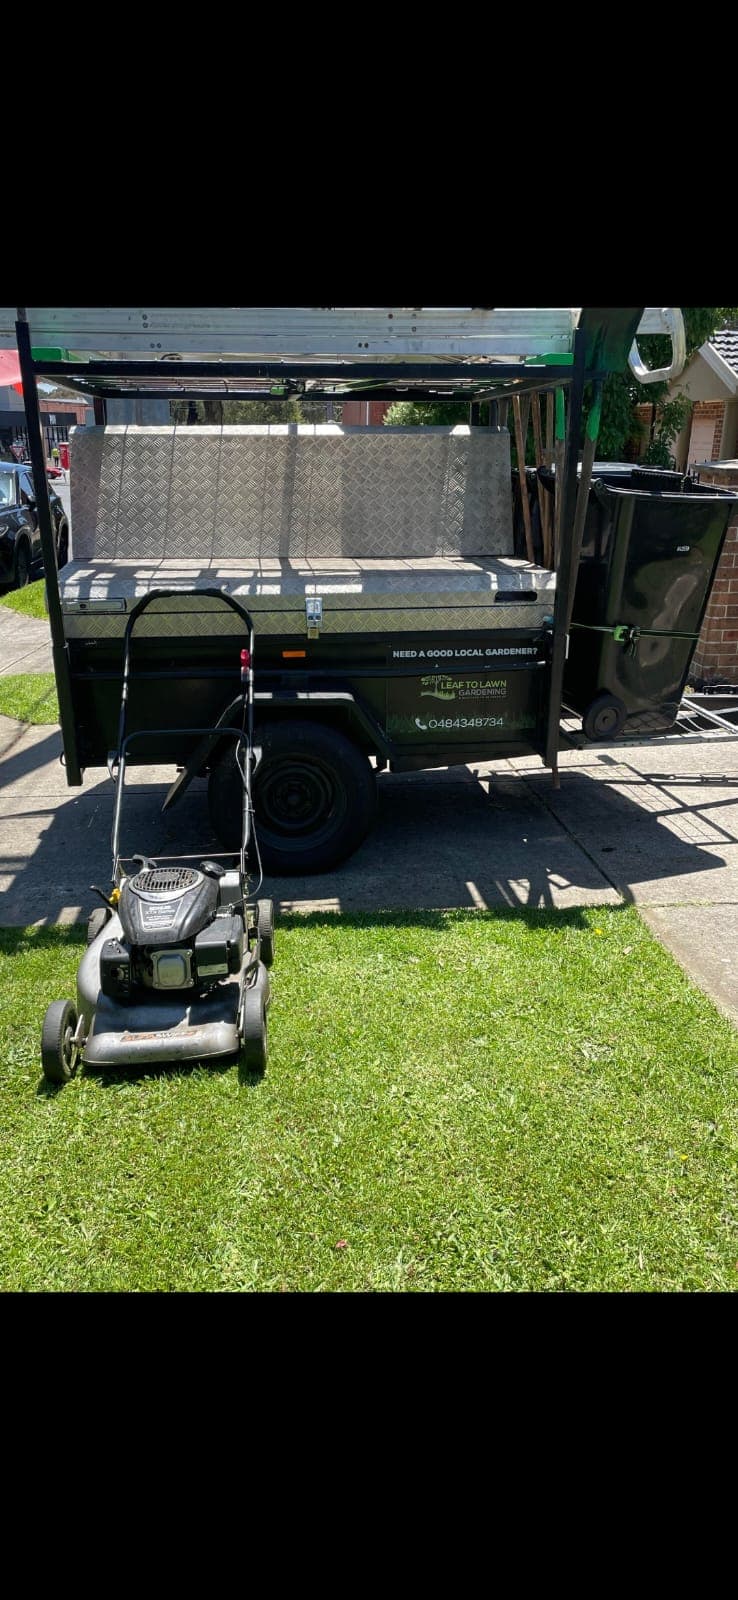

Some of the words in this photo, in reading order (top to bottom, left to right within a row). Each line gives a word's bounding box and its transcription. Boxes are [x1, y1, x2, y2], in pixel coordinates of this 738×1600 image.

[393, 650, 417, 658] NEED
[418, 650, 426, 658] A
[427, 649, 453, 658] GOOD
[455, 649, 484, 657] LOCAL
[485, 647, 538, 656] GARDENER?
[441, 681, 465, 690] LEAF
[465, 680, 479, 689] TO
[480, 679, 507, 688] LAWN
[458, 688, 507, 696] GARDENING
[428, 717, 504, 729] 0484348734
